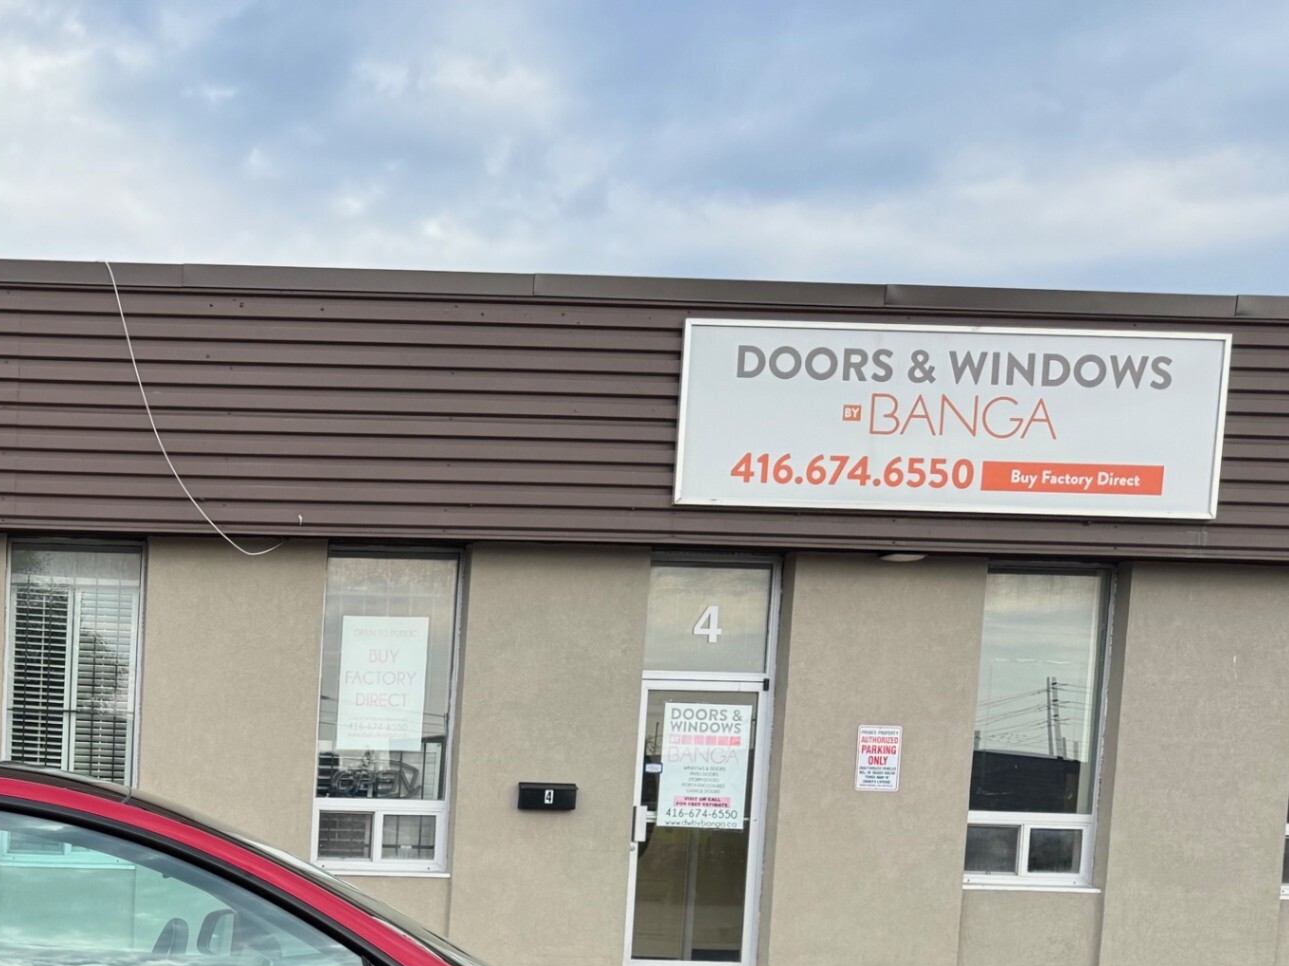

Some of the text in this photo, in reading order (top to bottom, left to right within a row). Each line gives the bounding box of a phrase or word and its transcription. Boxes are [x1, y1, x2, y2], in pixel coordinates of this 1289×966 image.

[736, 345, 1174, 390] DOORS & WINDOWS
[844, 393, 1057, 440] BY BANGA
[730, 453, 1141, 490] 416.674.6550 Buy Factory Direct
[693, 605, 722, 643] 4
[353, 628, 376, 637] OPEN
[368, 649, 400, 663] BUY
[344, 671, 417, 686] FACTORY
[355, 692, 409, 707] DIRECT
[671, 708, 743, 722] DOORS &
[670, 721, 742, 734] WINDOWS
[861, 736, 898, 744] AUTHORIZED
[667, 746, 740, 764] BANGA
[861, 745, 897, 755] PARKING
[868, 756, 888, 765] ONLY
[545, 791, 552, 803] 4
[665, 808, 738, 820] 416-674-6550
